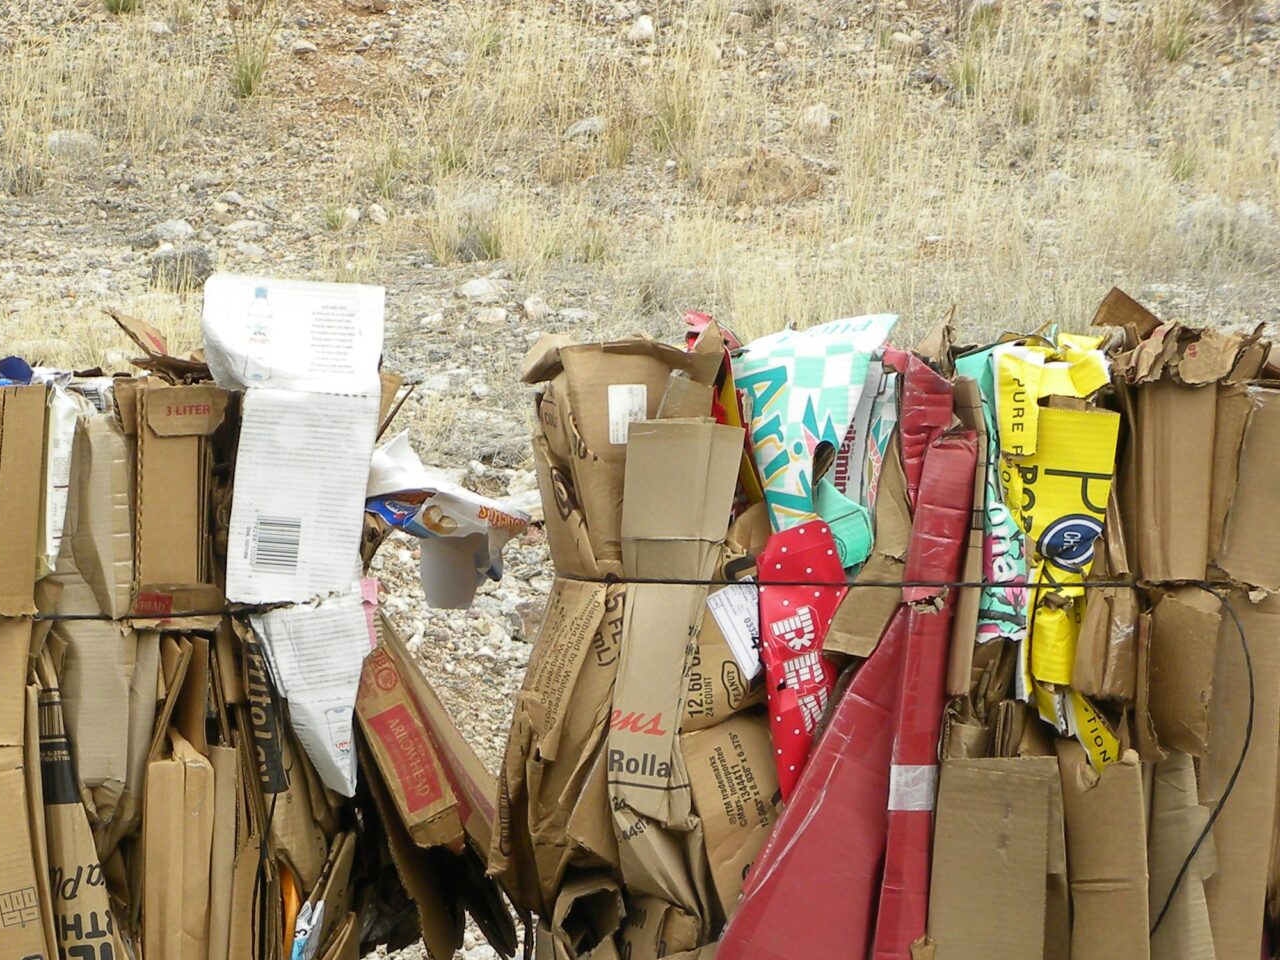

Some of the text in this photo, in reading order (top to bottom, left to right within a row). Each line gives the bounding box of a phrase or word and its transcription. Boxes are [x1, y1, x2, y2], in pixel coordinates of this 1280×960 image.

[166, 404, 211, 416] 3 LITER
[576, 601, 601, 651] Distributed
[546, 643, 565, 688] Walgreen
[725, 670, 745, 705] PEANUT
[770, 607, 830, 735] PEZ
[556, 670, 572, 715] Walgreen
[703, 676, 714, 705] COUNT
[386, 717, 431, 797] ARROWHEAD
[709, 754, 728, 801] trademarks
[713, 747, 736, 794] Incorporated
